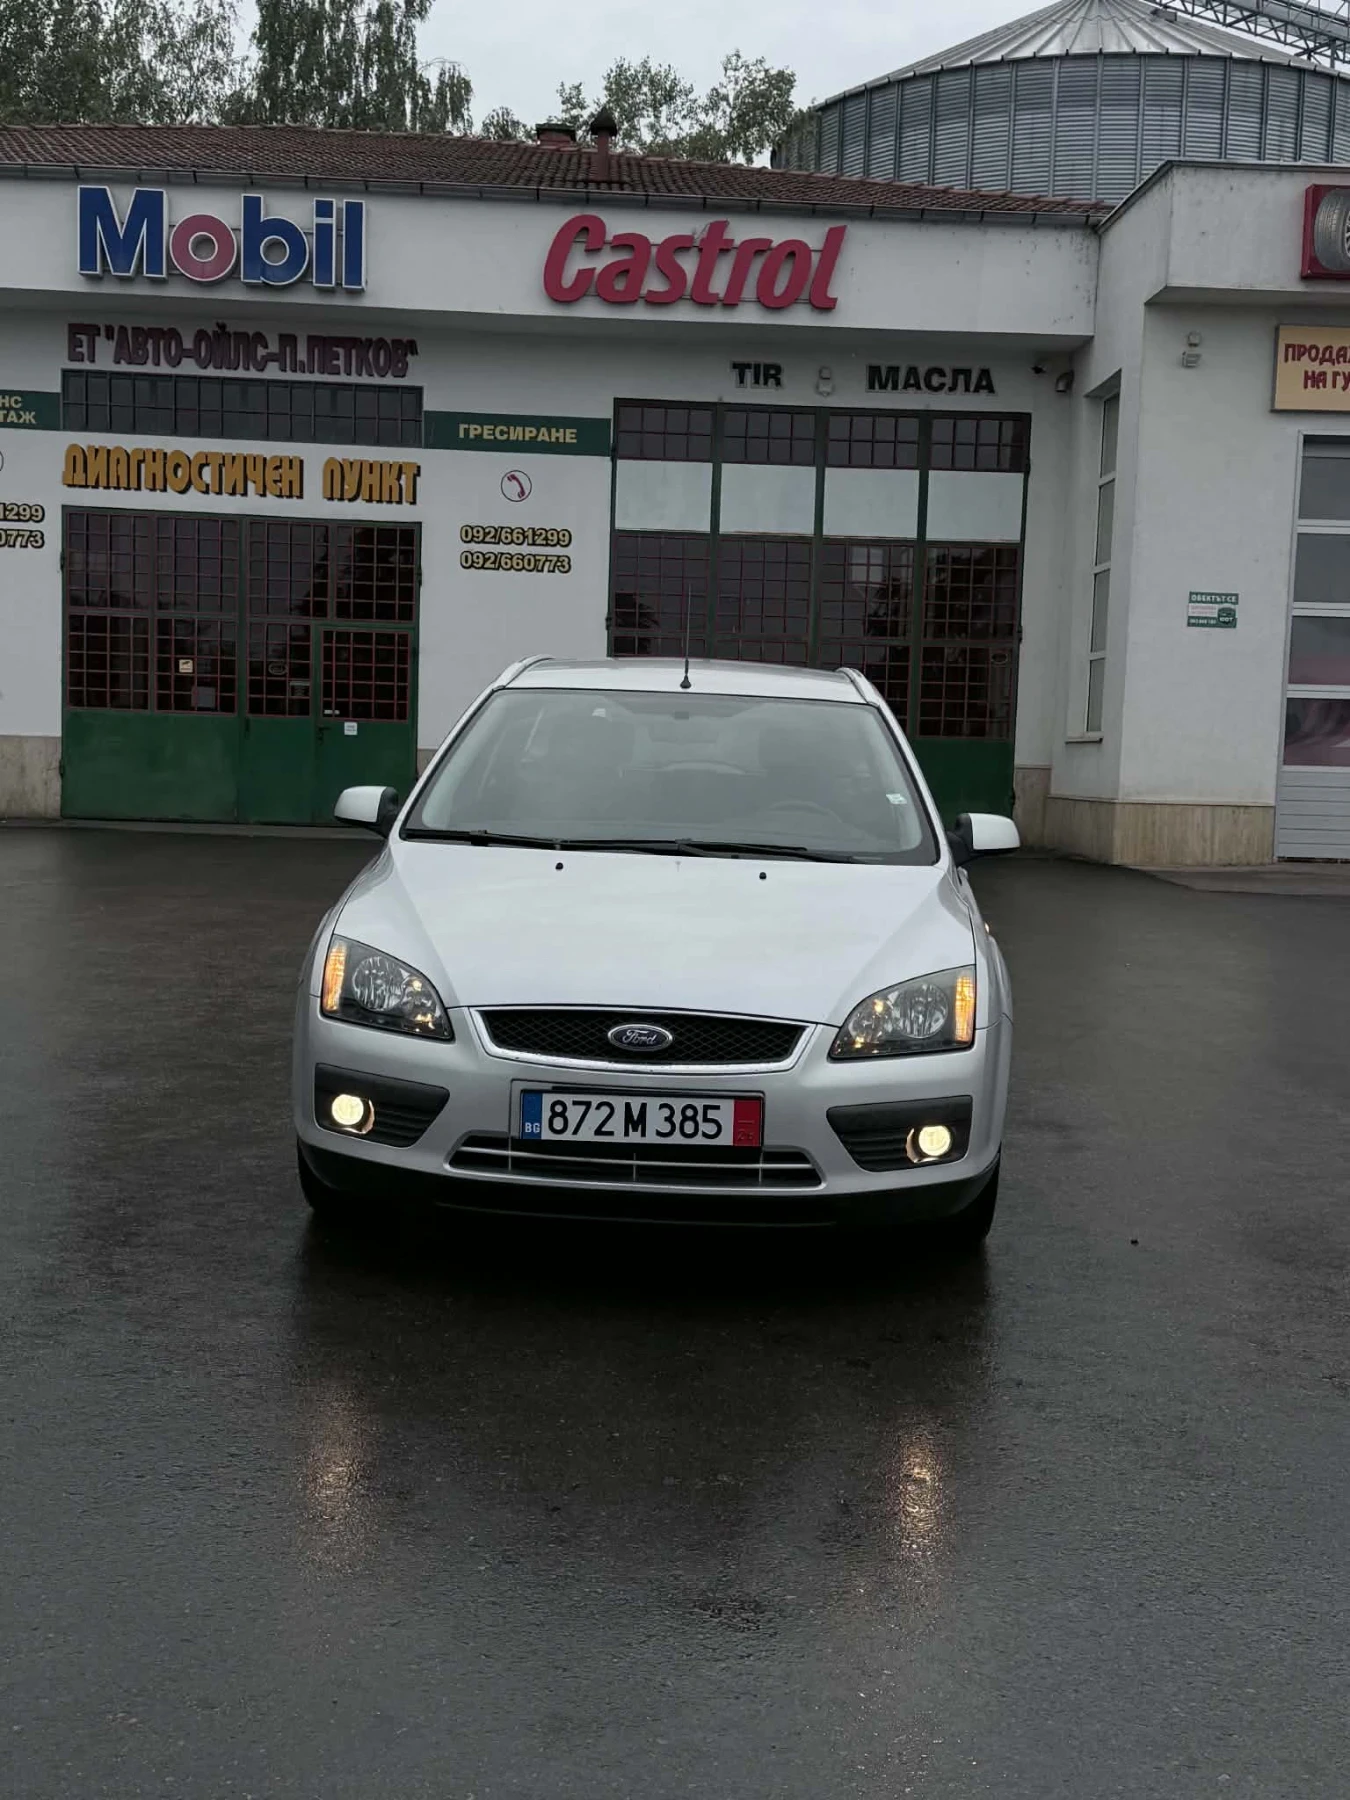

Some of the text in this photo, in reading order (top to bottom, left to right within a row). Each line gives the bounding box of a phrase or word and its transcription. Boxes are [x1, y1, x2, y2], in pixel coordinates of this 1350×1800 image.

[77, 185, 367, 291] Mobil
[543, 213, 847, 311] Castrol
[67, 322, 101, 363] ЕТ
[1284, 343, 1350, 366] ПРОДА
[731, 362, 783, 389] TIR
[867, 364, 997, 395] МАСЛА
[1303, 369, 1327, 390] НА
[458, 423, 578, 443] ГРЕСИРАНЕ
[62, 443, 421, 505] ДИАГНОСТИЧЕН ПУНКТ
[460, 524, 572, 547] 092/661299
[460, 550, 571, 574] 092/660773
[622, 1029, 657, 1045] Ford
[524, 1121, 541, 1134] BG
[548, 1100, 723, 1140] 872 M 385
